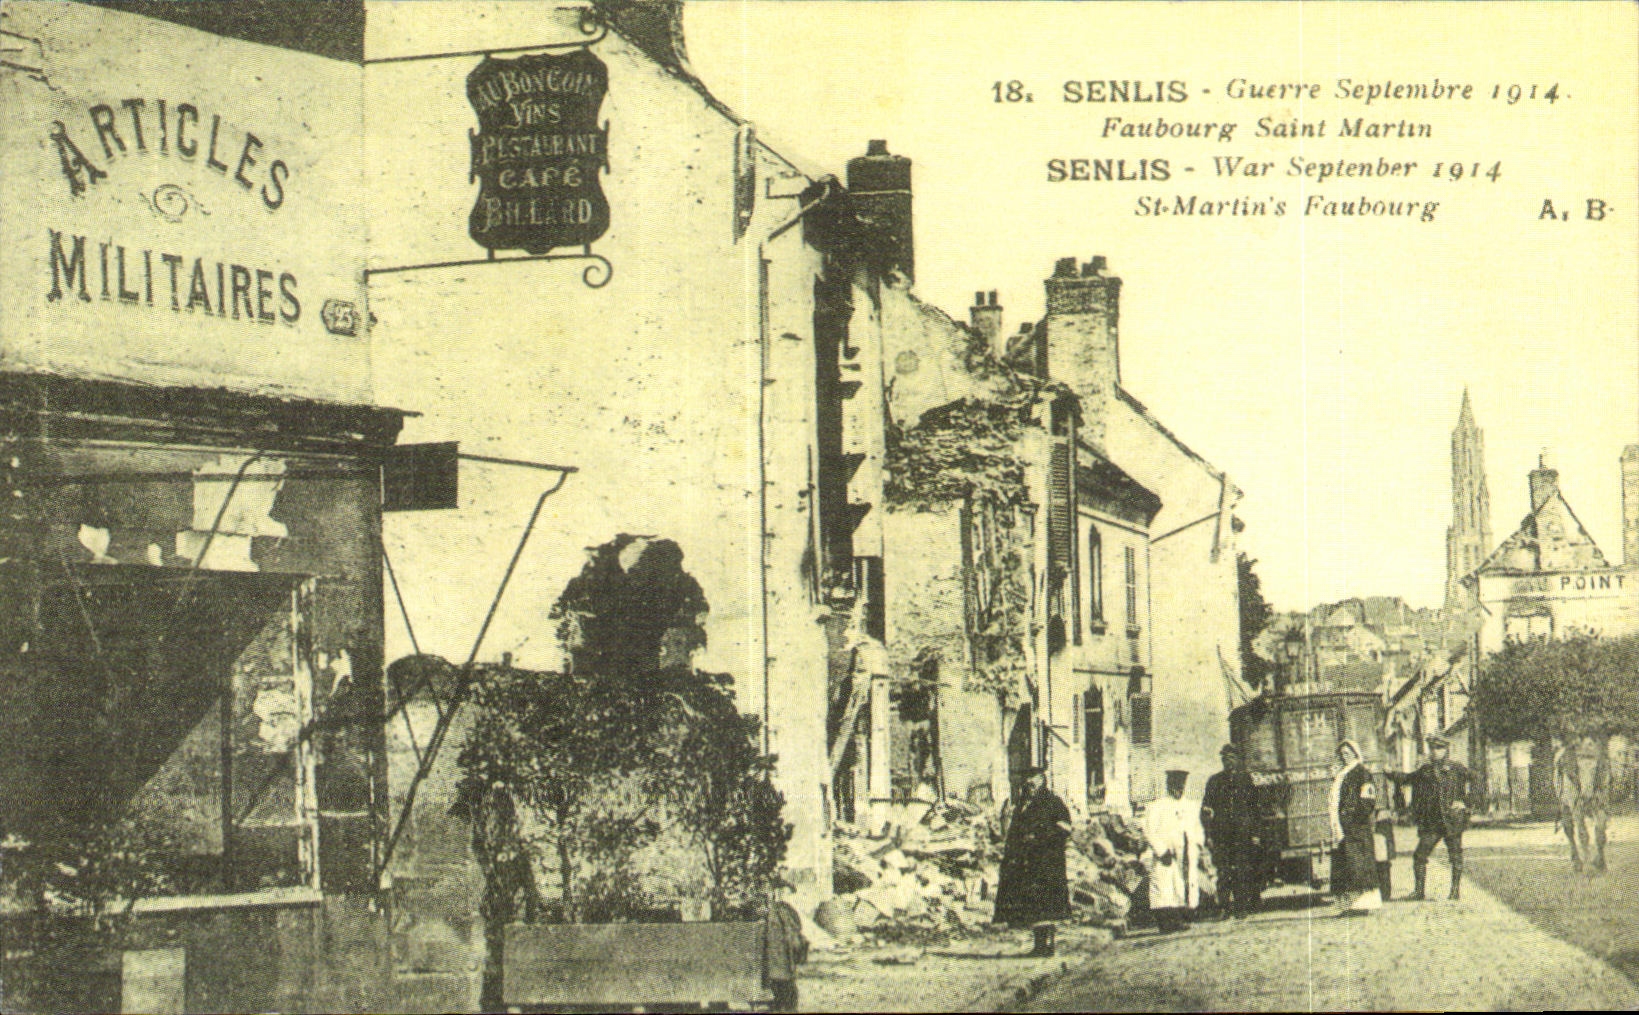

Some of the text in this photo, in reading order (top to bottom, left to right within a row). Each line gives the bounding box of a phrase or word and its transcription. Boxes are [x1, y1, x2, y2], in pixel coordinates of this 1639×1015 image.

[501, 98, 561, 129] VINS
[50, 98, 289, 210] ARTICLES
[481, 133, 598, 166] RESTAURANT
[499, 160, 582, 189] CAFÉ
[47, 229, 301, 325] MILITAIRES
[1560, 574, 1626, 591] POINT
